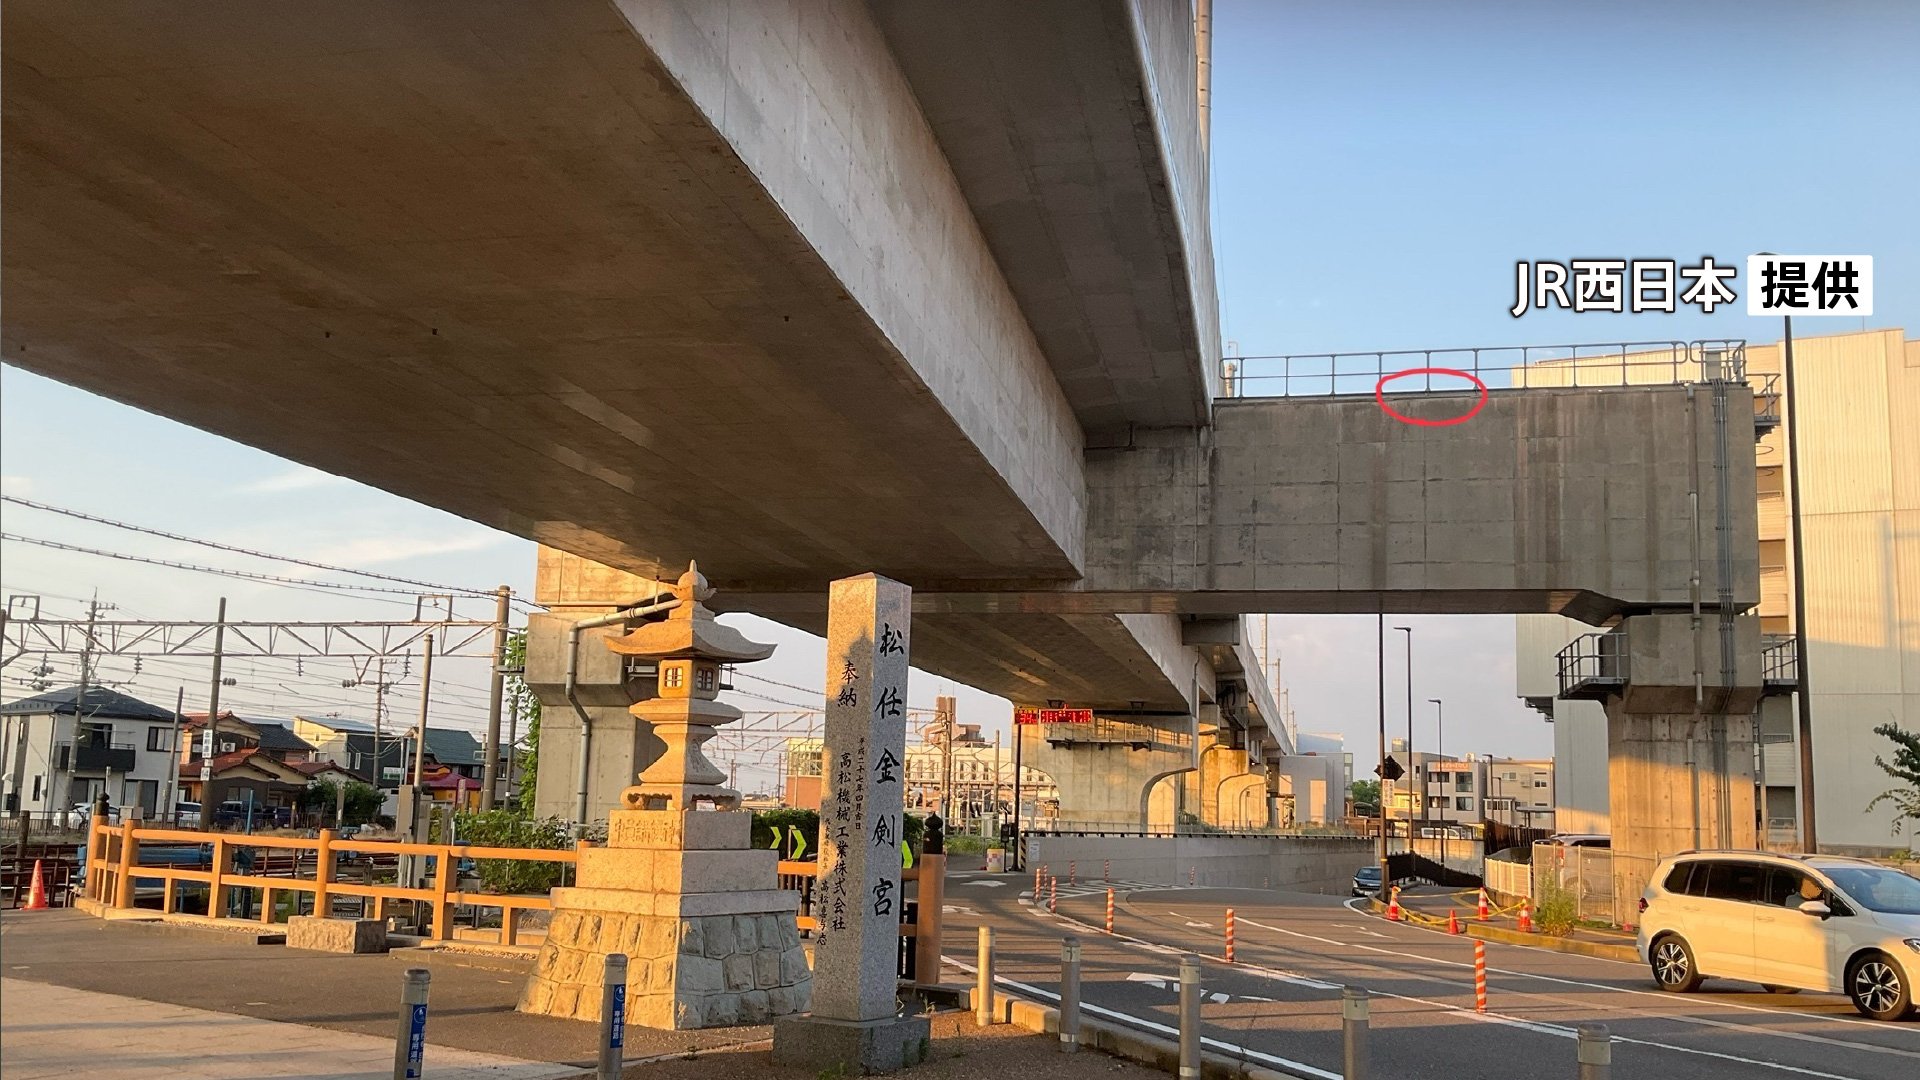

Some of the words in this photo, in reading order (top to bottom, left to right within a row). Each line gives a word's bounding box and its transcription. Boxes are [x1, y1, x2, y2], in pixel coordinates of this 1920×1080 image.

[838, 661, 859, 708] 奉納
[855, 738, 865, 830] 平成二十七年四月吉日
[871, 622, 904, 916] 松任金剣宮
[832, 752, 851, 932] 高松機械工業株式会社
